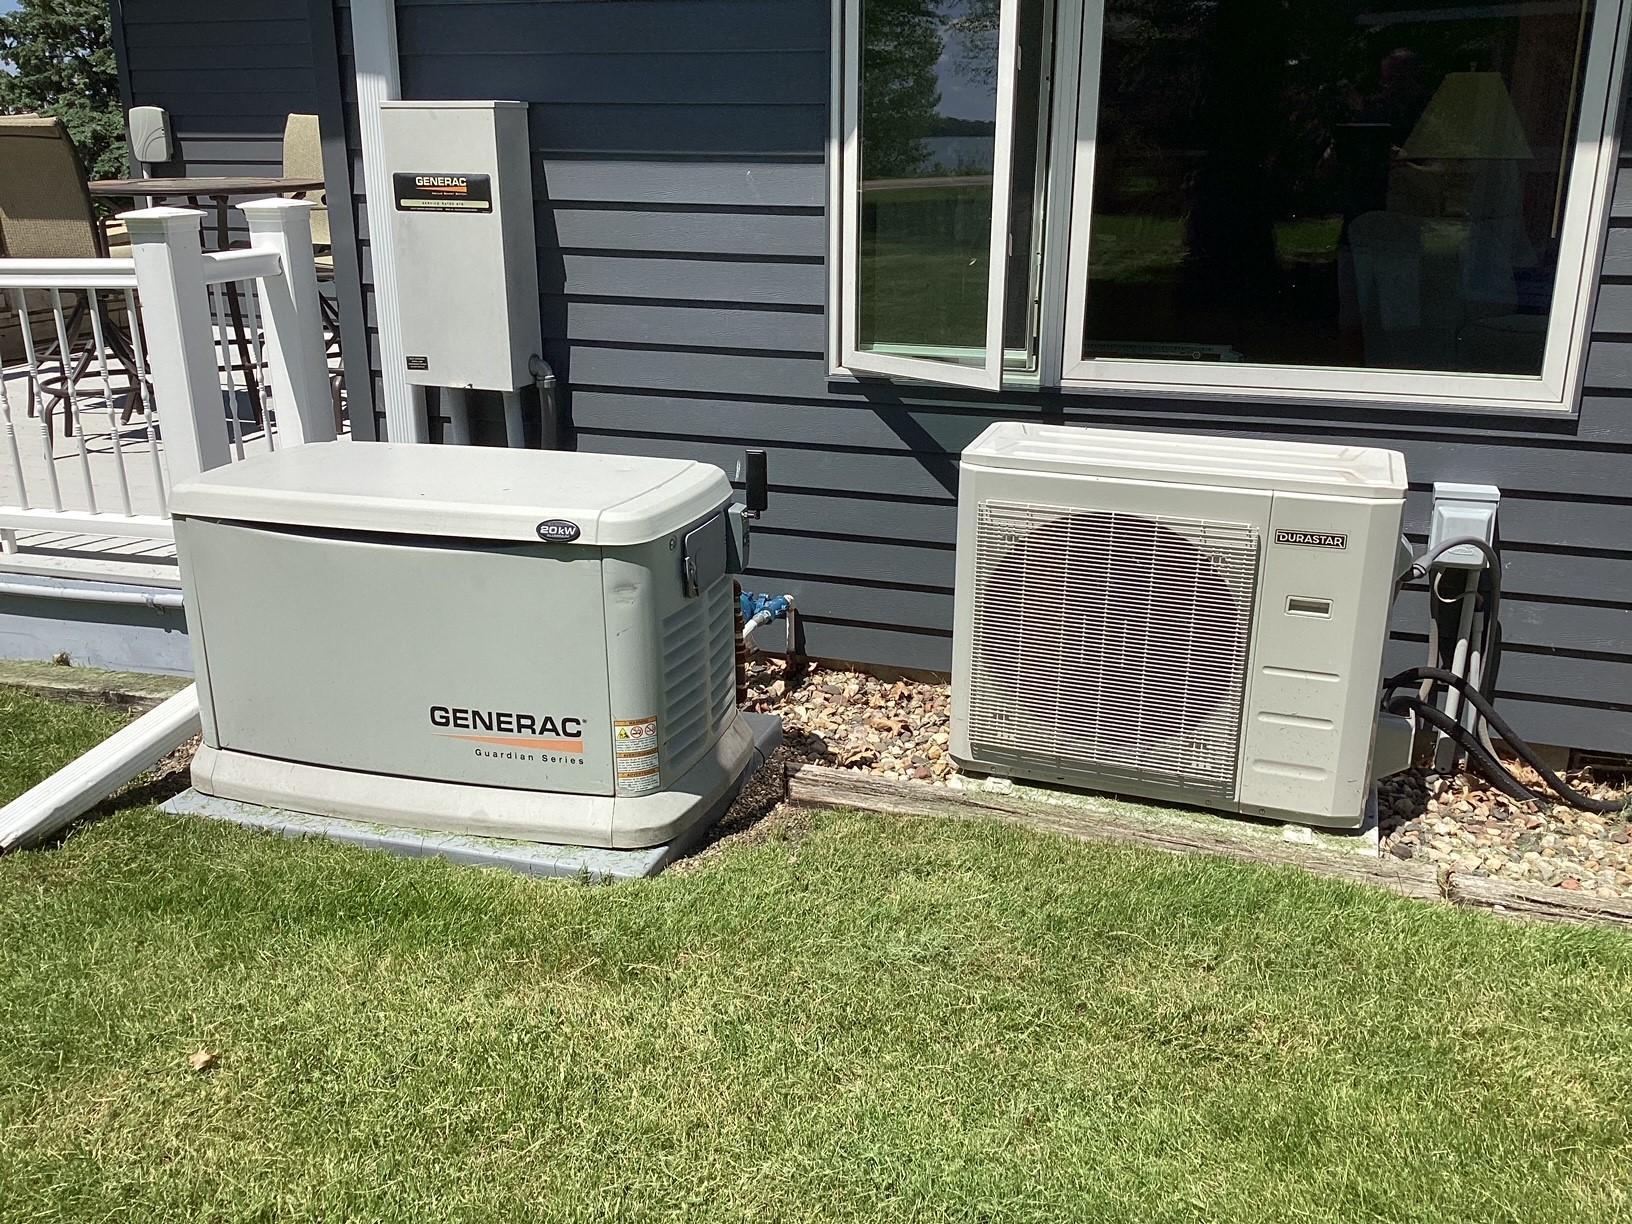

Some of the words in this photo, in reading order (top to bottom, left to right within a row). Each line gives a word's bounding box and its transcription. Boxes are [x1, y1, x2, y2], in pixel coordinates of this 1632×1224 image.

[415, 176, 467, 186] GENERAC
[540, 525, 576, 536] 20kW
[1279, 533, 1343, 548] DURASTAR
[429, 705, 582, 738] GENERAC
[474, 748, 534, 761] Guardian
[541, 754, 584, 765] Series
